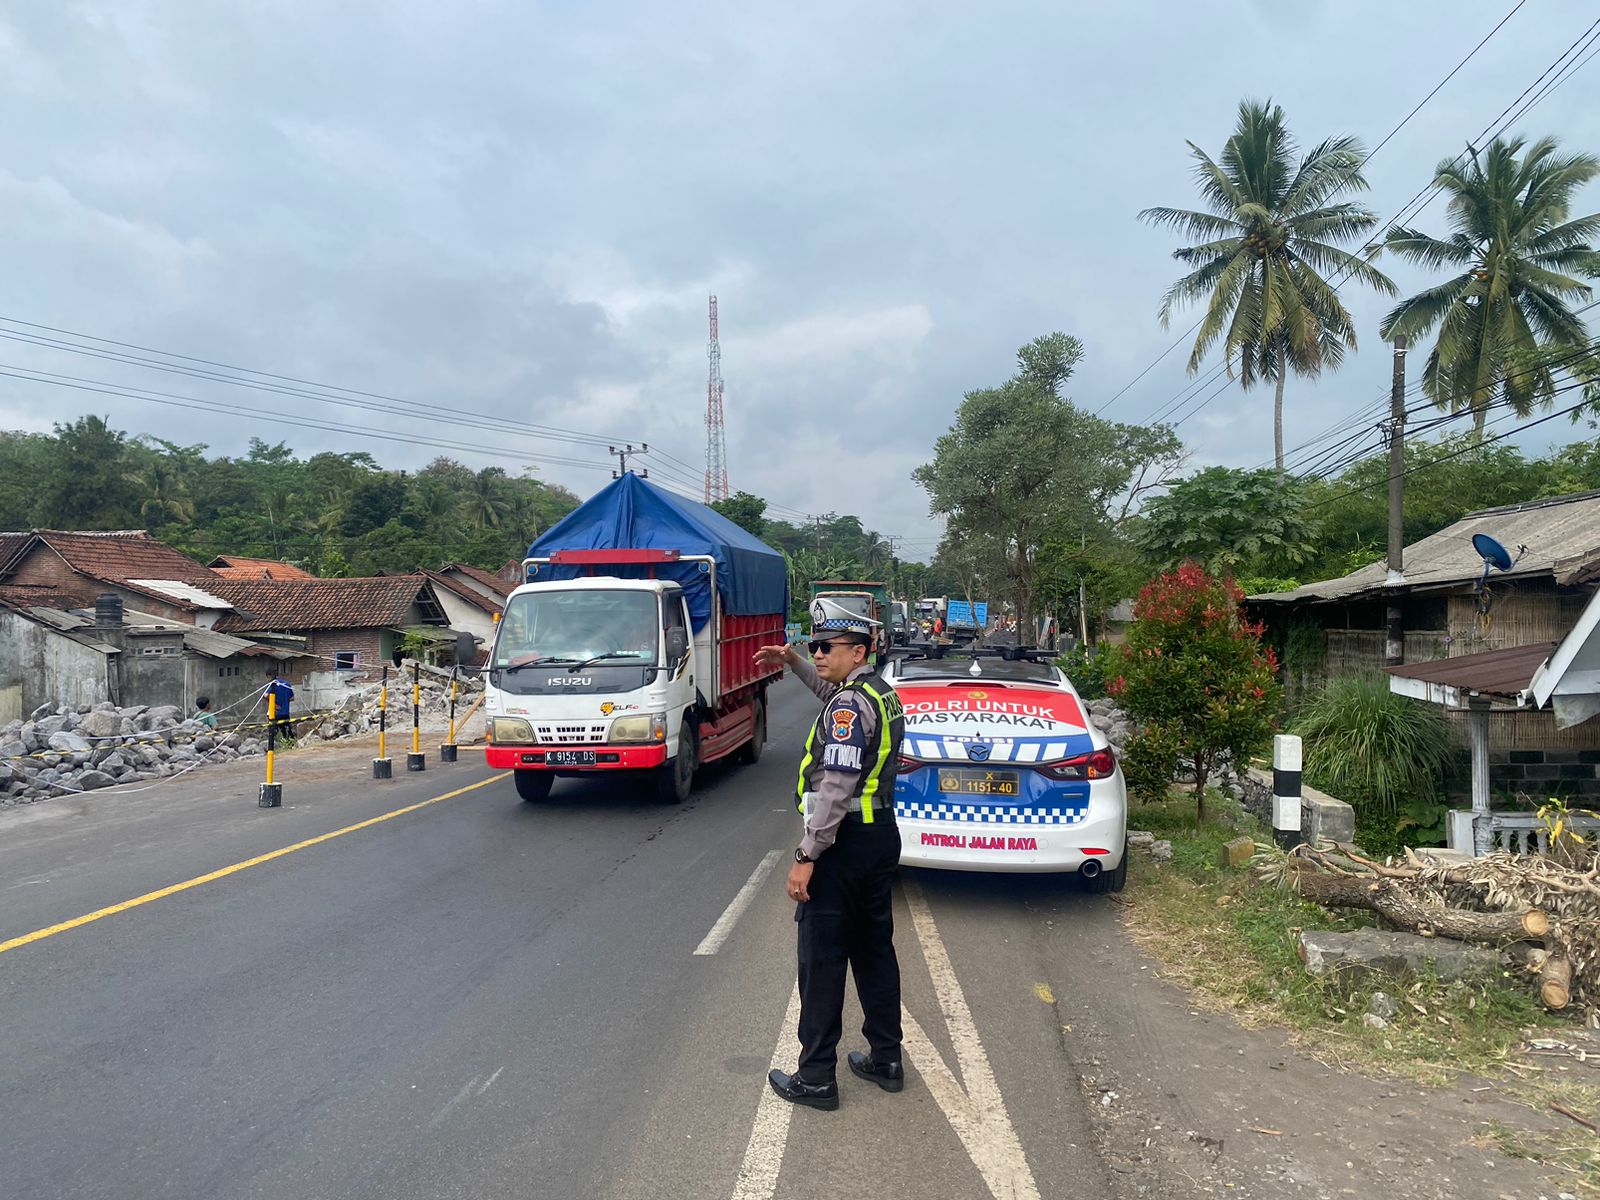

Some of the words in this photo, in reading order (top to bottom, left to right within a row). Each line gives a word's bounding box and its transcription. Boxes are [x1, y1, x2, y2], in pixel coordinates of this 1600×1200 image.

[548, 677, 591, 686] ISUZU
[903, 700, 968, 713] POLRI
[976, 700, 1054, 719] UNTUK
[904, 712, 1056, 731] MASYARAKAT
[546, 752, 551, 760] K
[557, 752, 576, 761] 9154
[583, 751, 594, 760] DS
[986, 772, 993, 780] X
[920, 832, 966, 848] PATROLI
[969, 836, 1005, 849] JALAN
[1008, 837, 1038, 850] RAYA
